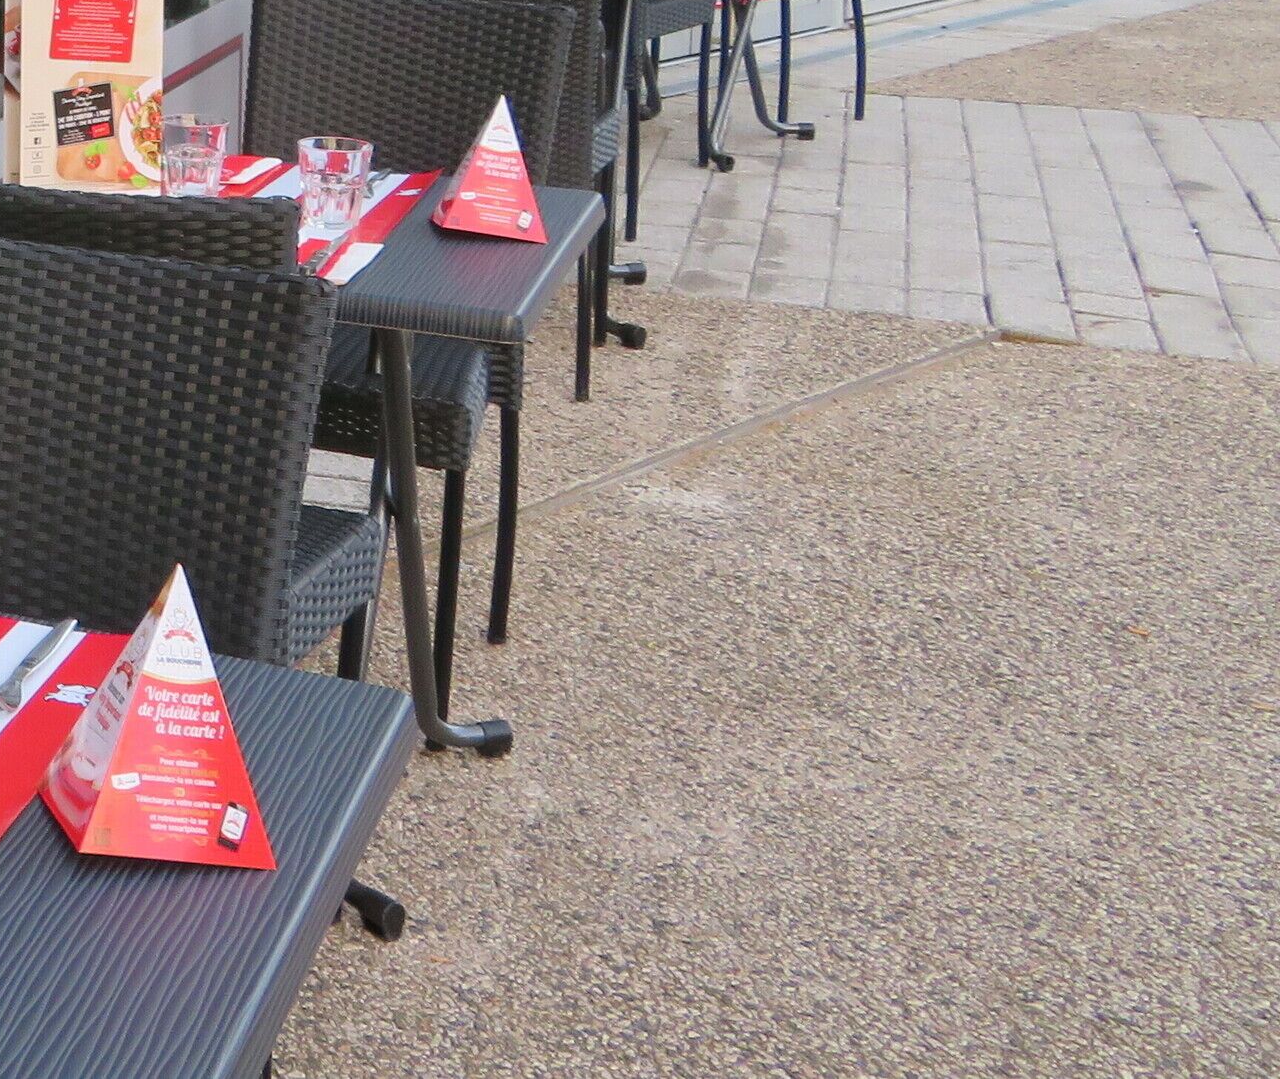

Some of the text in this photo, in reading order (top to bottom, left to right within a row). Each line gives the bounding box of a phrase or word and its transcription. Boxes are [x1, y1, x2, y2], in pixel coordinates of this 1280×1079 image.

[145, 685, 215, 707] Votre carte
[137, 702, 220, 723] de fidélité est
[156, 718, 225, 740] à la carte !
